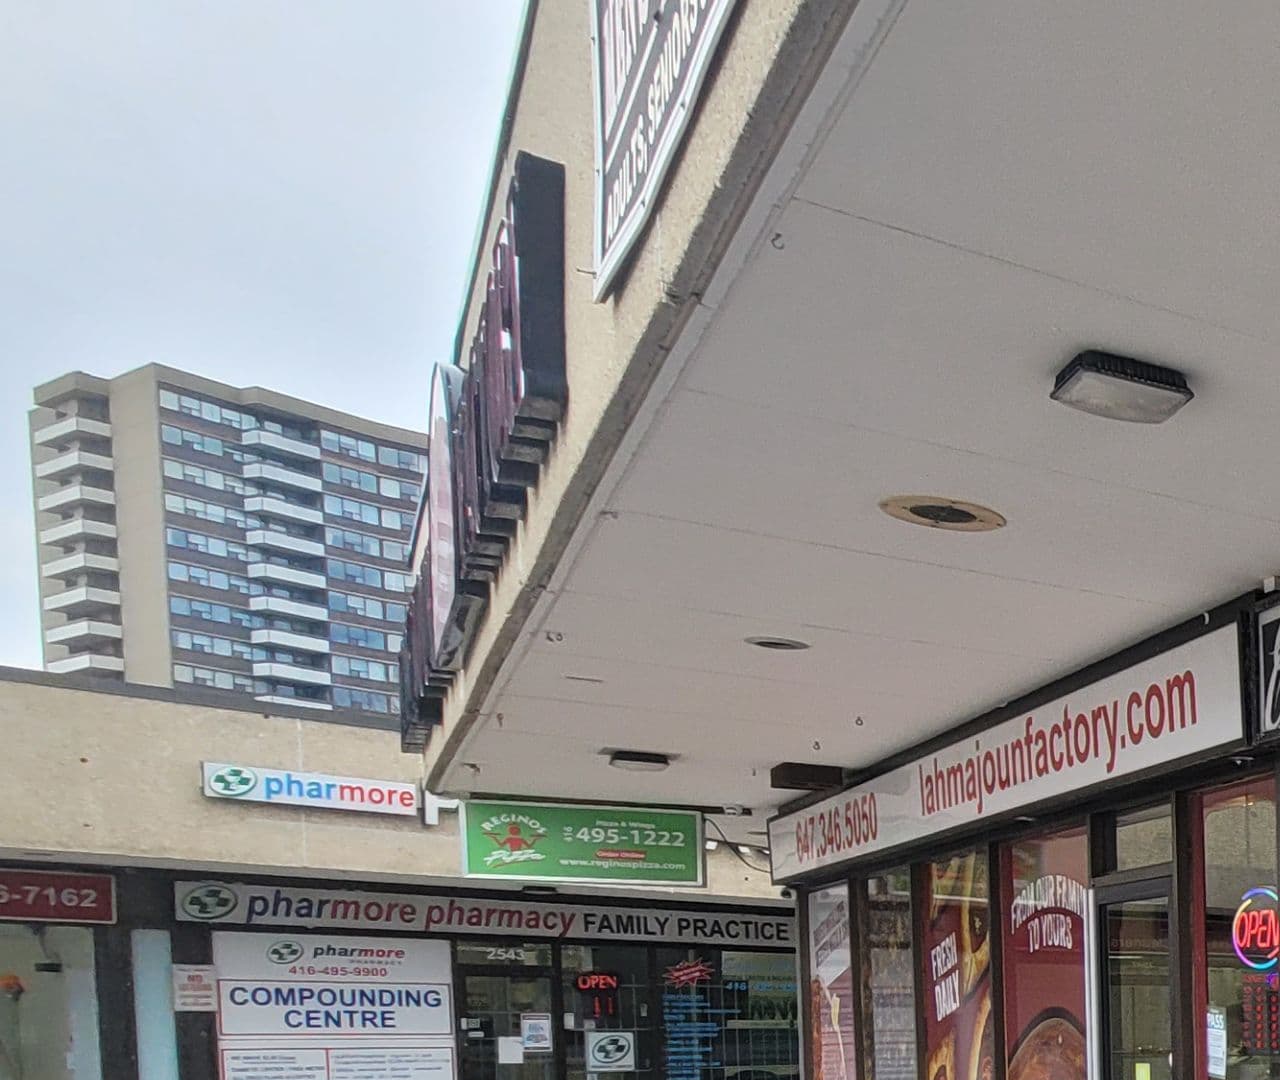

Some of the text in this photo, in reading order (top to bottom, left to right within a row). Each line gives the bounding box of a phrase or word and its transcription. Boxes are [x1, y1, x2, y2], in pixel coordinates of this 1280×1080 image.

[606, 114, 648, 248] ADULTS,
[918, 670, 1198, 817] lahmajounfactory.com
[264, 774, 414, 807] pharmore
[481, 814, 547, 834] REGINOS
[576, 827, 685, 847] 495-1222
[796, 792, 878, 864] 647.346.5050
[247, 889, 416, 924] pharmore
[425, 901, 575, 937] pharmacy
[584, 913, 671, 937] FAMILY
[677, 917, 789, 941] PRACTICE
[1237, 910, 1280, 948] OPEN
[1028, 913, 1072, 952] TO YOURS
[312, 945, 405, 959] pharmore
[487, 949, 526, 961] 2543
[931, 932, 957, 982] FRESH
[289, 966, 388, 977] 416-495-9900
[577, 975, 618, 989] OPEN
[229, 987, 442, 1008] COMPOUNDING
[935, 970, 960, 1023] DAILY
[284, 1009, 397, 1028] CENTRE
